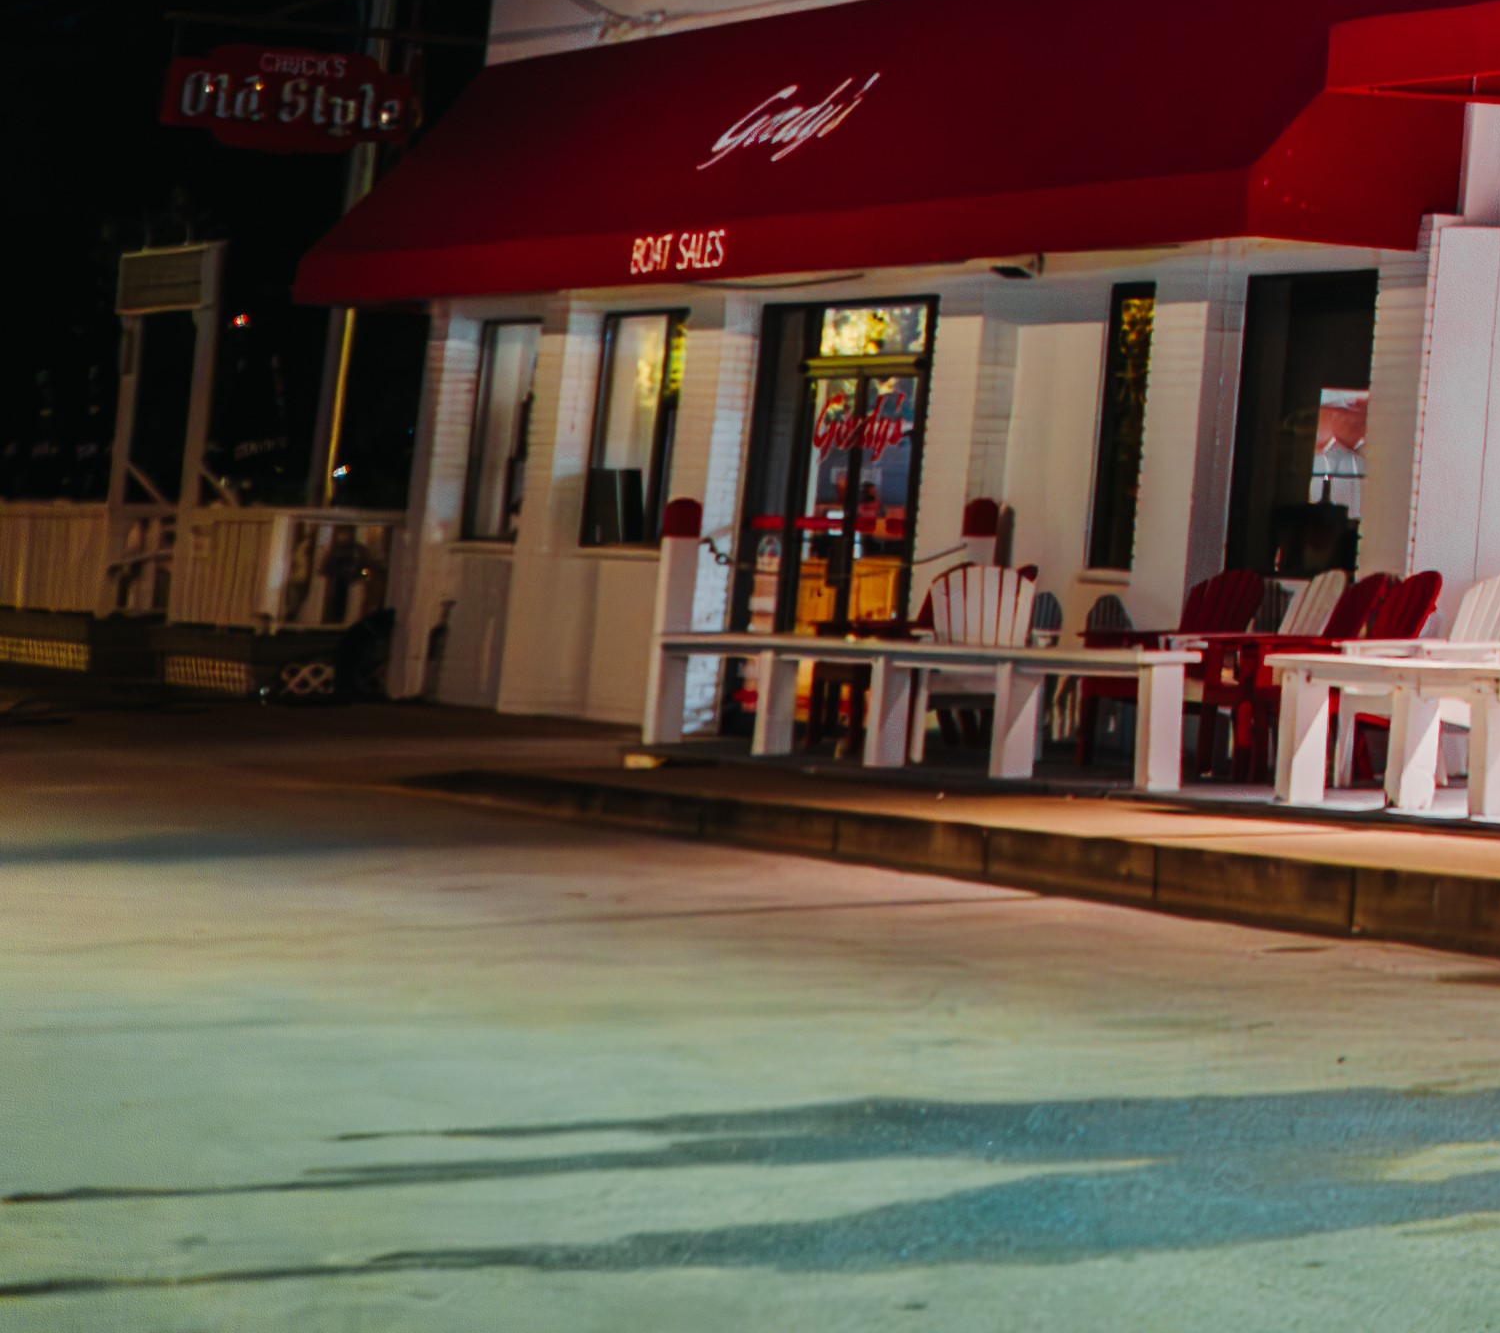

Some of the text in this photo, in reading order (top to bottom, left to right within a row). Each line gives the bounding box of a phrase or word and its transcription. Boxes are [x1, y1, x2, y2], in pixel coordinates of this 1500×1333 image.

[180, 70, 401, 138] Old Style
[695, 71, 882, 171] Gordy's
[630, 228, 726, 275] BOAT SALES
[812, 391, 906, 465] Gordy's
